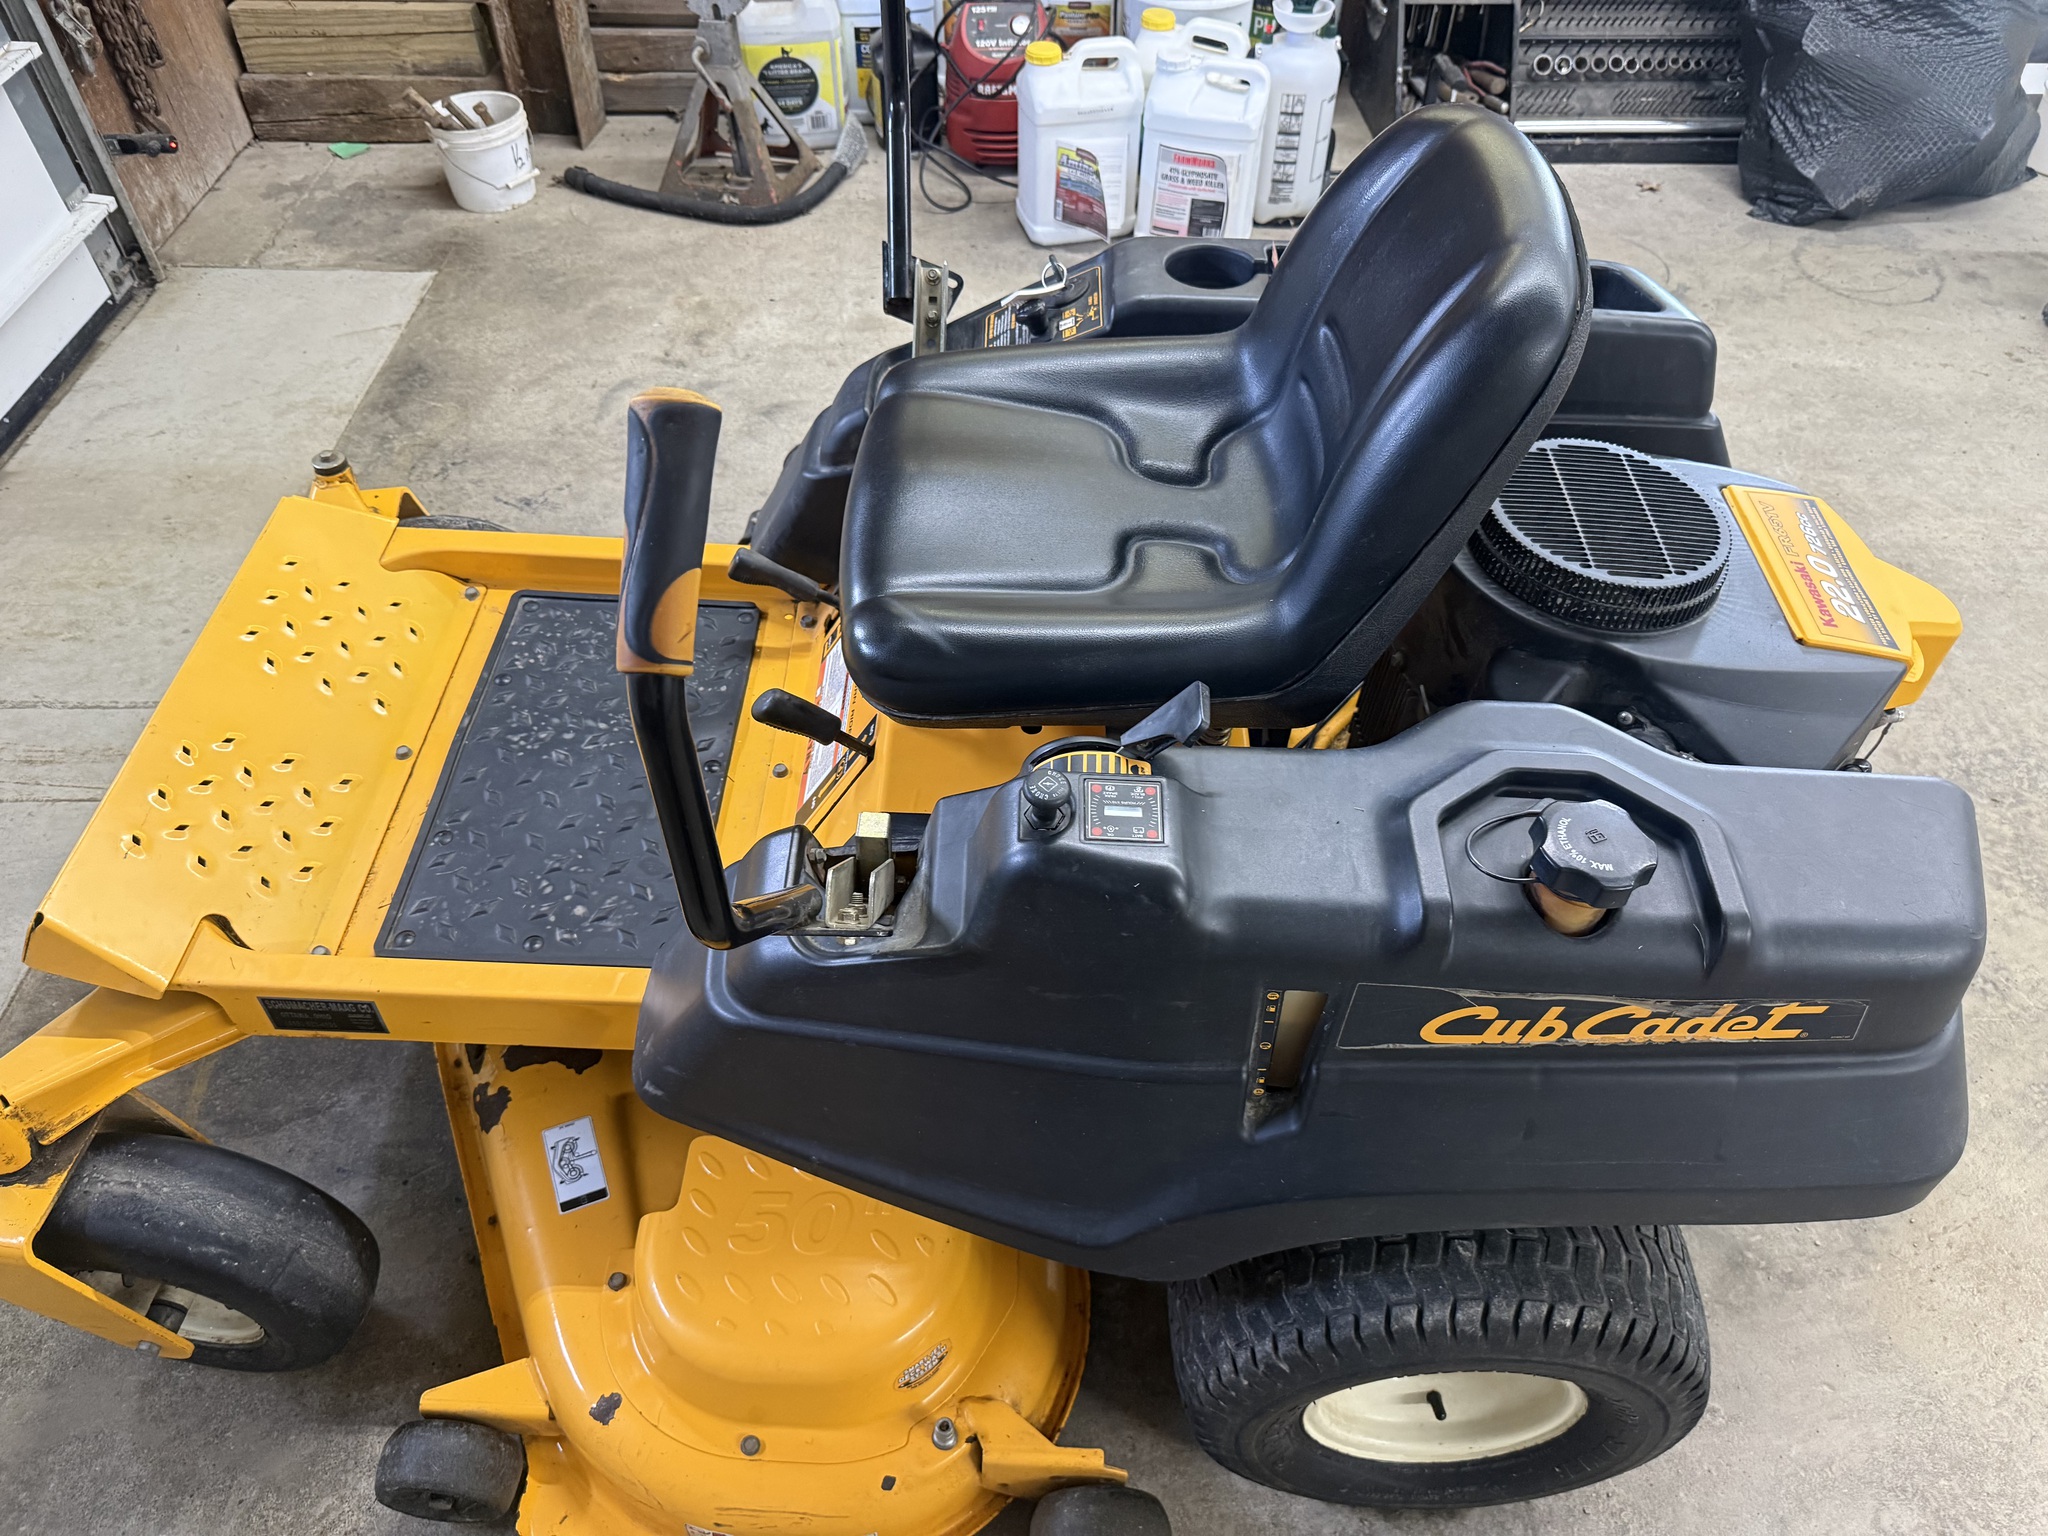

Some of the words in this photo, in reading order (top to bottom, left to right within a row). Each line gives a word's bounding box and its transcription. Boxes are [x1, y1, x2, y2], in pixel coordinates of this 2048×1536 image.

[976, 39, 996, 48] 120V
[1161, 174, 1179, 183] GRASS
[1187, 178, 1203, 186] WEED
[1205, 180, 1224, 189] KILLER
[1759, 500, 1800, 557] FR651V
[1796, 511, 1827, 556] 726cc
[1790, 560, 1838, 629] Kawasaki
[1806, 554, 1866, 624] 22.0
[1029, 785, 1049, 800] CHOKE
[1556, 817, 1572, 850] ETHANOL
[1569, 849, 1587, 864] 10%
[1589, 860, 1614, 872] MAX.
[264, 1000, 357, 1012] SCHUMACHER-MAAG
[1419, 1005, 1568, 1044] Cub
[1572, 1003, 1830, 1042] Cadet
